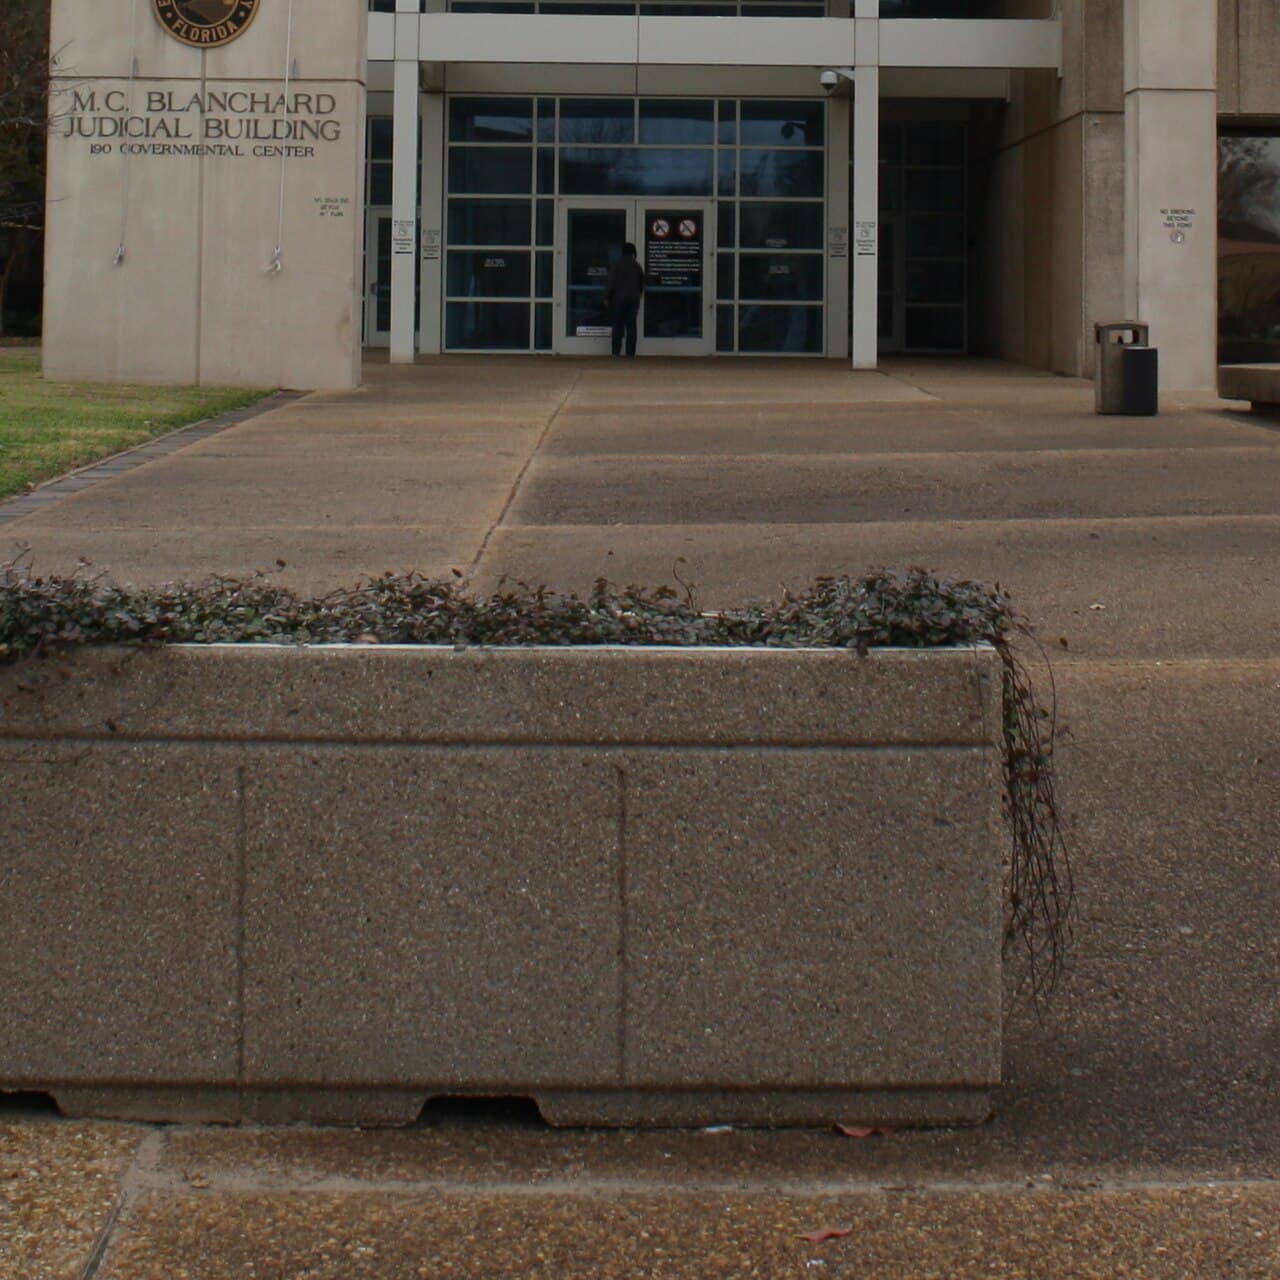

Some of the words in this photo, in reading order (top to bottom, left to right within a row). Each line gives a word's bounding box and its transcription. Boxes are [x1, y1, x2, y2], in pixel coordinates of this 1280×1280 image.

[171, 19, 238, 42] FLORIDA
[146, 91, 336, 114] BLANCHARD
[64, 116, 193, 138] JUDICIAL
[204, 118, 341, 141] BUILDING
[90, 143, 112, 155] 190
[120, 143, 244, 157] GOVERNMENTAL
[252, 145, 314, 158] CENTER
